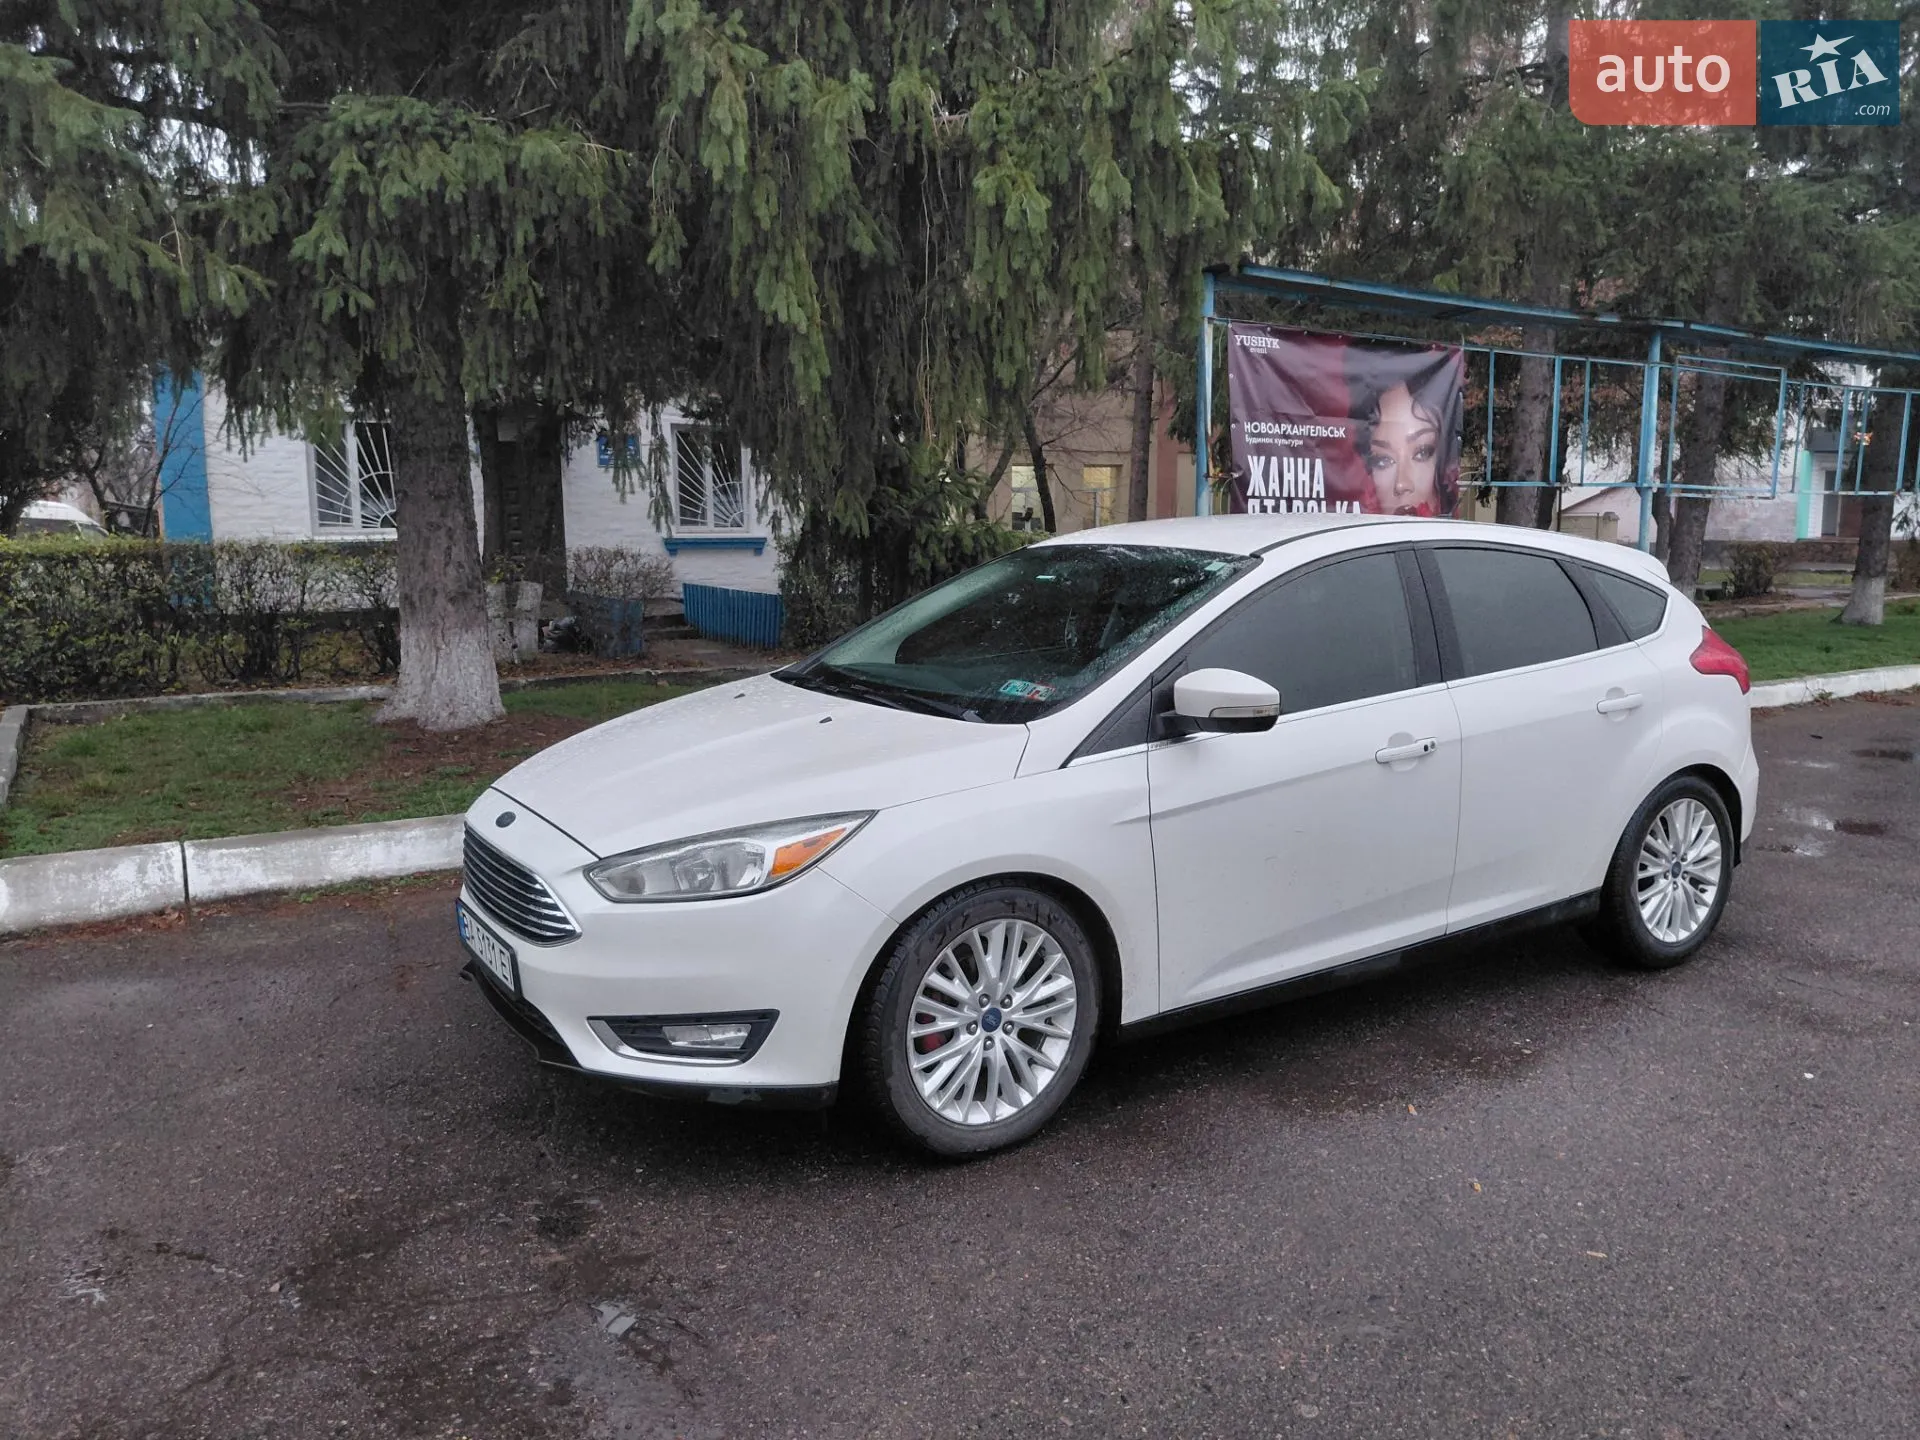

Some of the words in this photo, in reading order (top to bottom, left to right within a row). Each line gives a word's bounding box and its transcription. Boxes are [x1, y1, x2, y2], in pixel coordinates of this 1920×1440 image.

[1234, 334, 1280, 349] YUSHYK
[1244, 421, 1346, 438] НОВОАРХАНГЕЛЬСЬК
[1245, 433, 1274, 445] Будинок
[1274, 437, 1304, 448] культури
[1246, 455, 1326, 499] ЖАННА
